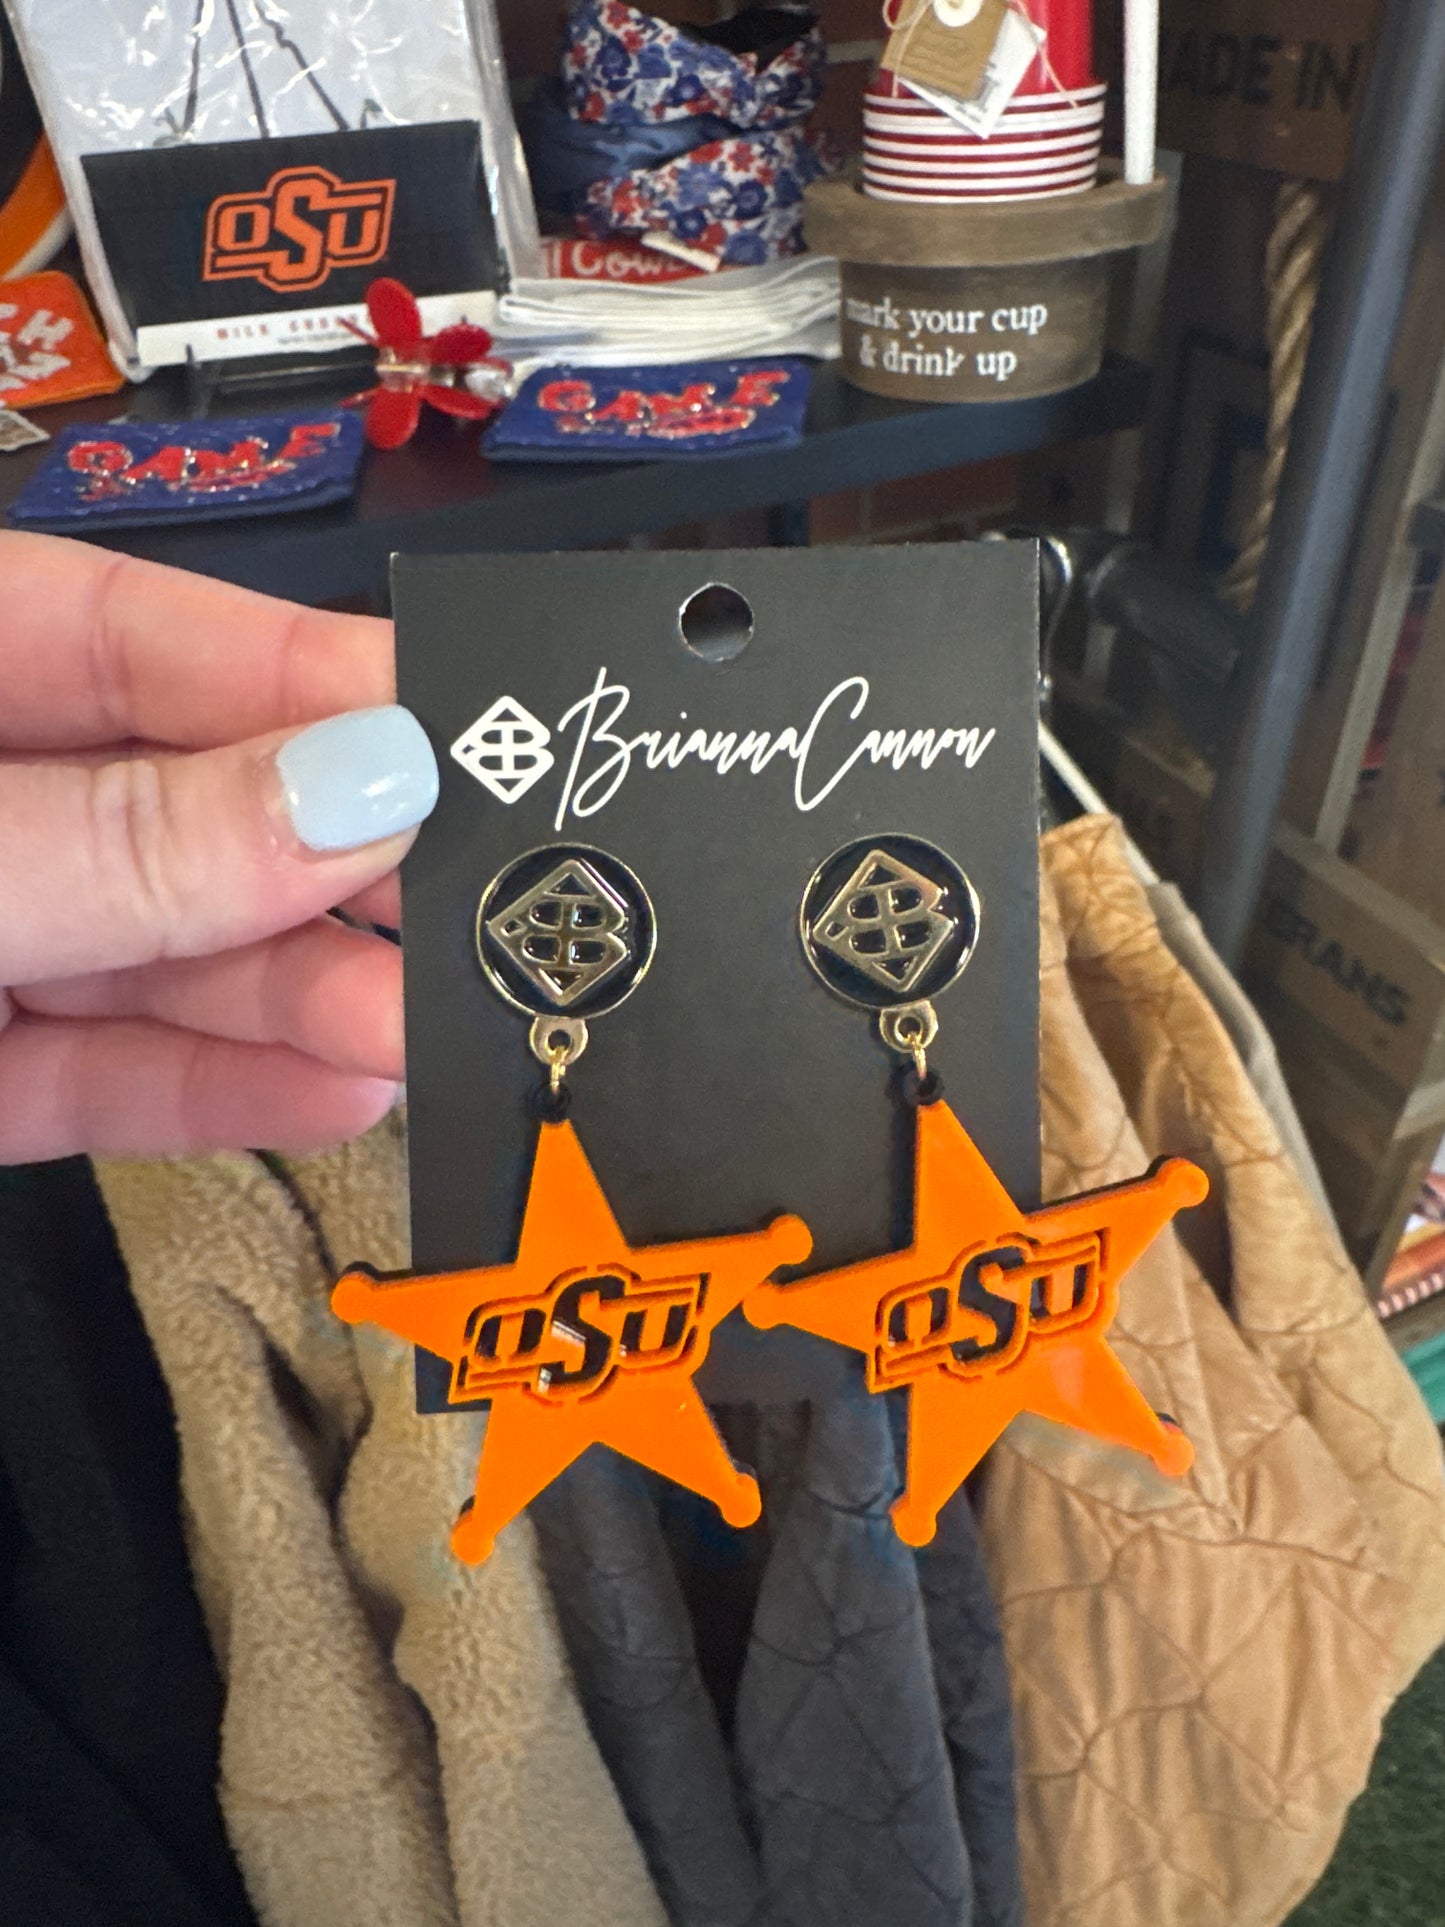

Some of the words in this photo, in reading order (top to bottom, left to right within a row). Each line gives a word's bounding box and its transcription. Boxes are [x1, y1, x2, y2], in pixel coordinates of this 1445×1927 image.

[206, 168, 394, 290] OSU
[882, 340, 966, 377] drink
[976, 350, 1018, 382] up
[908, 309, 985, 339] your
[991, 303, 1048, 336] cup
[465, 1266, 706, 1400] OSU
[880, 1234, 1107, 1377] OSU
